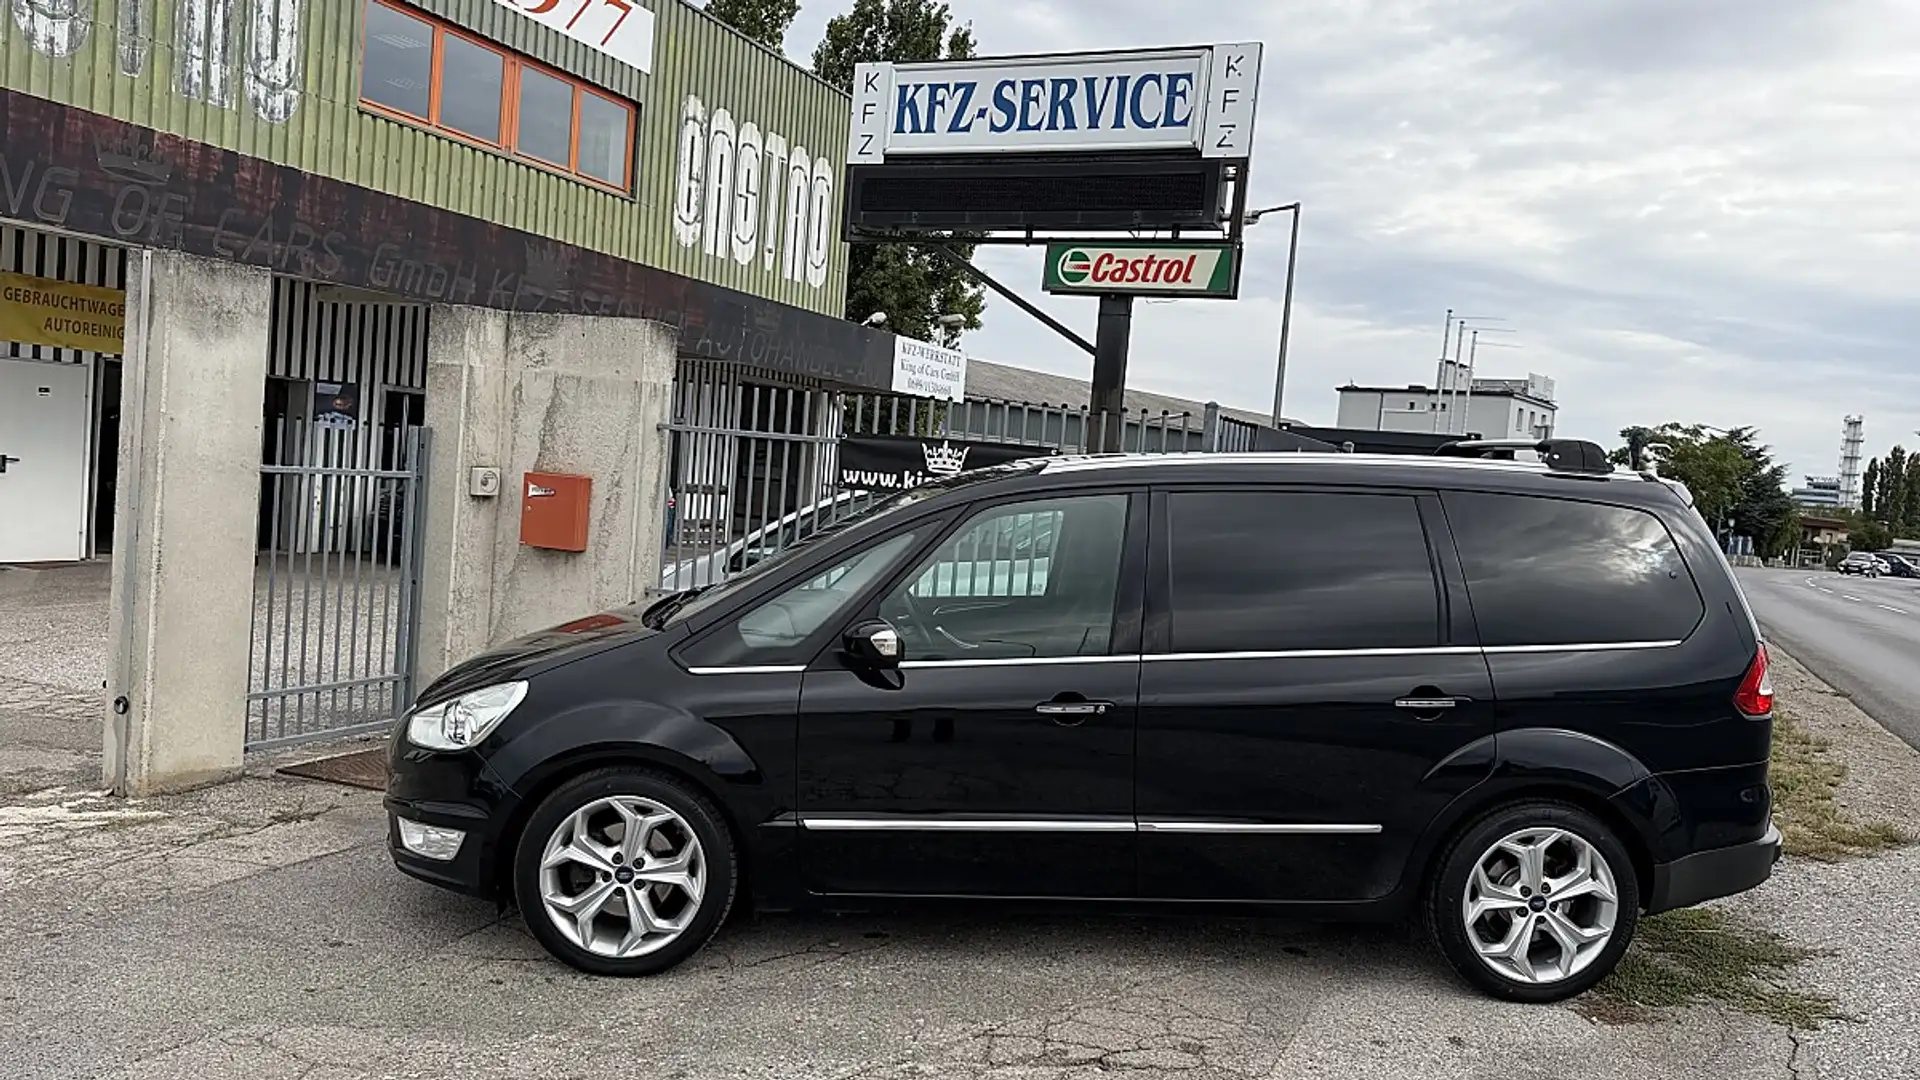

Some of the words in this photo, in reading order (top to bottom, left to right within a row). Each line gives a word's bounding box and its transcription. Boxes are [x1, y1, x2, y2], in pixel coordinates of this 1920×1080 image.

[858, 72, 880, 155] KFZ
[893, 73, 1194, 134] KFZ-SERVICE
[1216, 55, 1245, 148] KFZ
[112, 184, 188, 242] OF
[1091, 252, 1197, 284] Castrol
